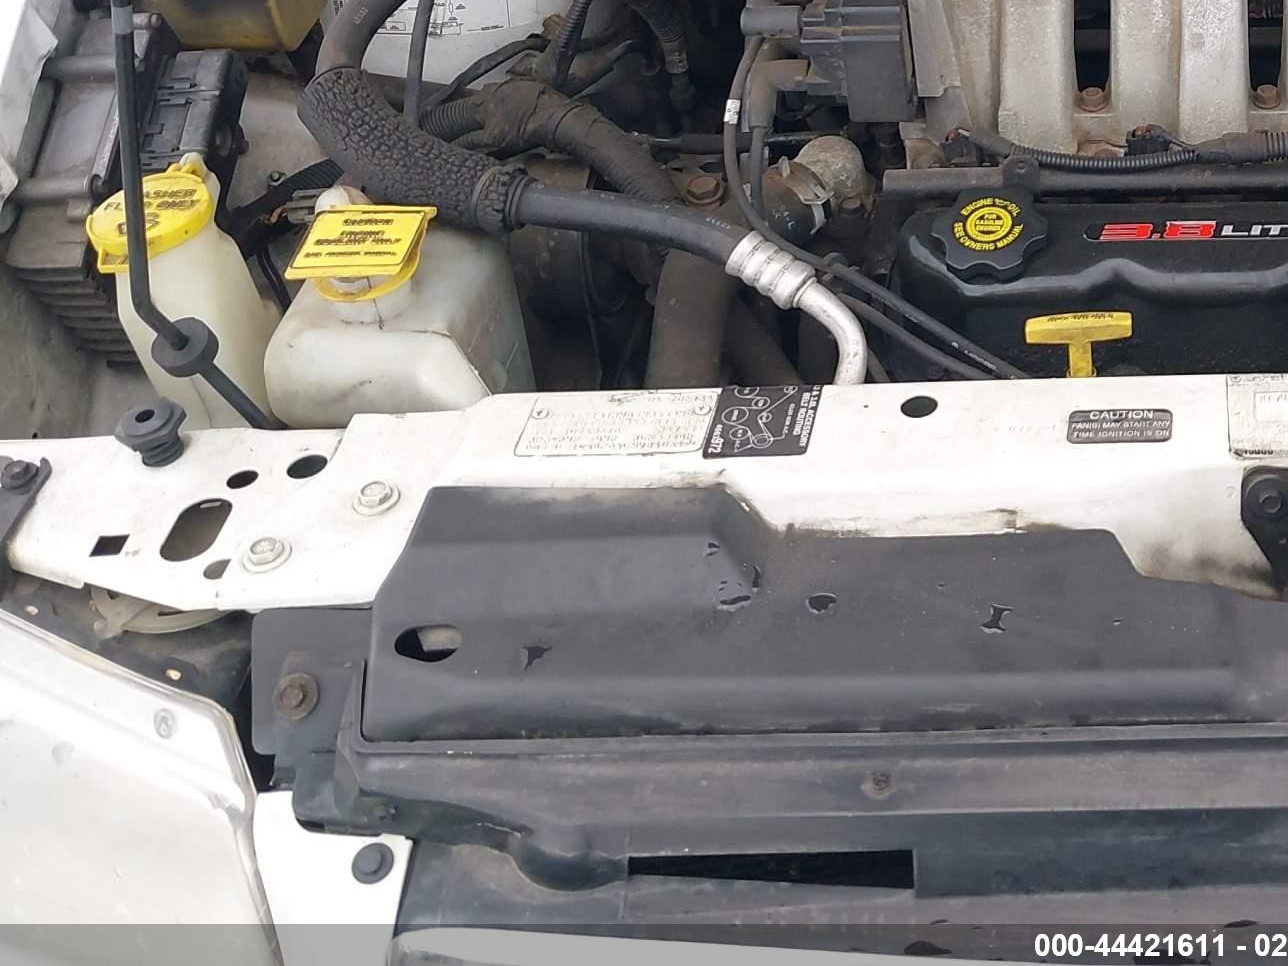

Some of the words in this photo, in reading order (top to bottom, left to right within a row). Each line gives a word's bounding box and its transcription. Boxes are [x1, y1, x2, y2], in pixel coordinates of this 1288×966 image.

[144, 189, 197, 199] ASHER
[104, 201, 152, 210] FLD
[961, 197, 994, 216] ENGINE
[1008, 203, 1021, 217] OIL
[954, 222, 965, 238] SEE
[960, 236, 995, 250] OWNERS
[996, 224, 1024, 249] MANUAL
[1100, 220, 1217, 240] 3.8
[800, 392, 811, 406] BELT
[793, 407, 807, 435] ROUTING
[1089, 410, 1153, 420] CAUTION
[799, 409, 815, 447] ACCESSORY
